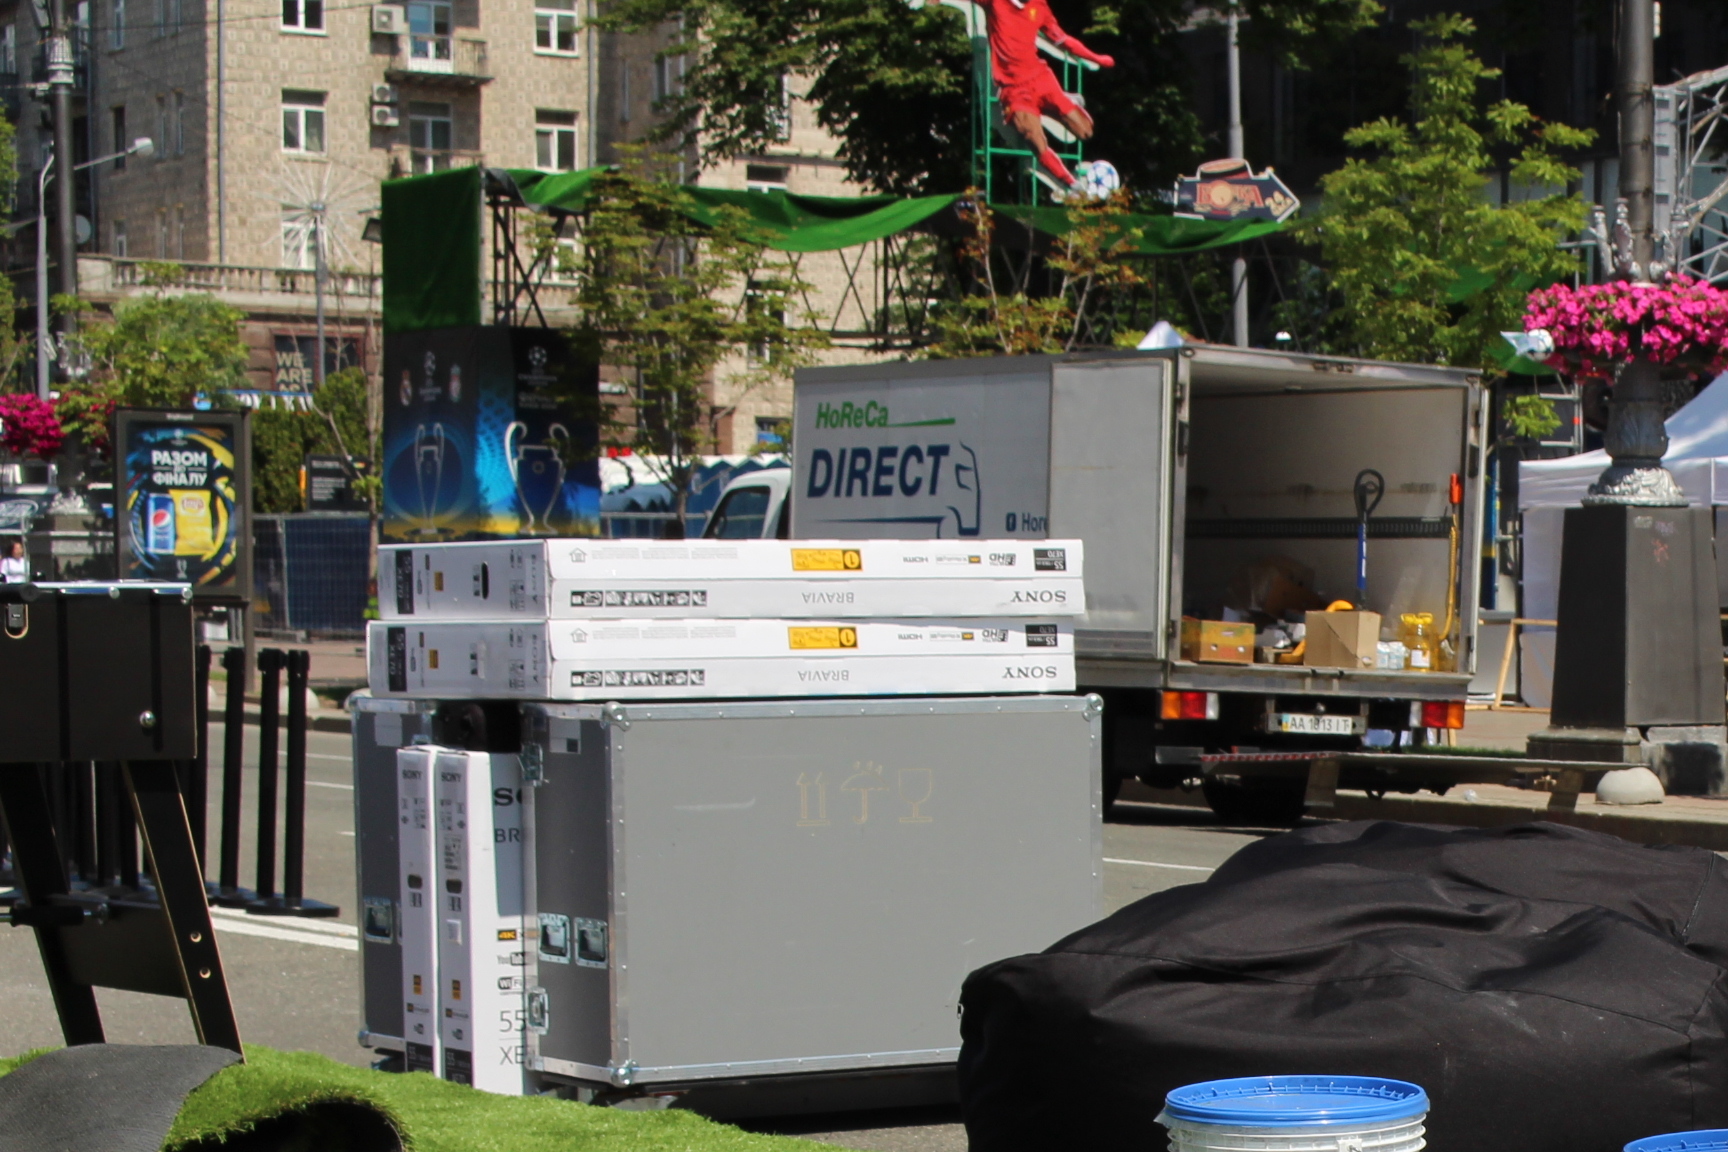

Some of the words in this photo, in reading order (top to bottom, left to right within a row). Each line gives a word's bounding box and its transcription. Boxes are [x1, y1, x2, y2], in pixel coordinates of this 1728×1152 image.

[276, 351, 305, 367] WE
[275, 368, 313, 384] ARE
[816, 401, 889, 429] HoReCa
[152, 451, 207, 466] РАЗОМ
[807, 444, 950, 498] DIRECT
[152, 472, 207, 486] ФІНАЛУ
[801, 592, 855, 604] BRAVIA
[1011, 590, 1067, 603] SONY
[797, 670, 850, 682] BRAVIA
[1002, 666, 1058, 678] SONY
[402, 769, 422, 780] SONY
[441, 772, 461, 782] SONY
[500, 1046, 525, 1066] XE
